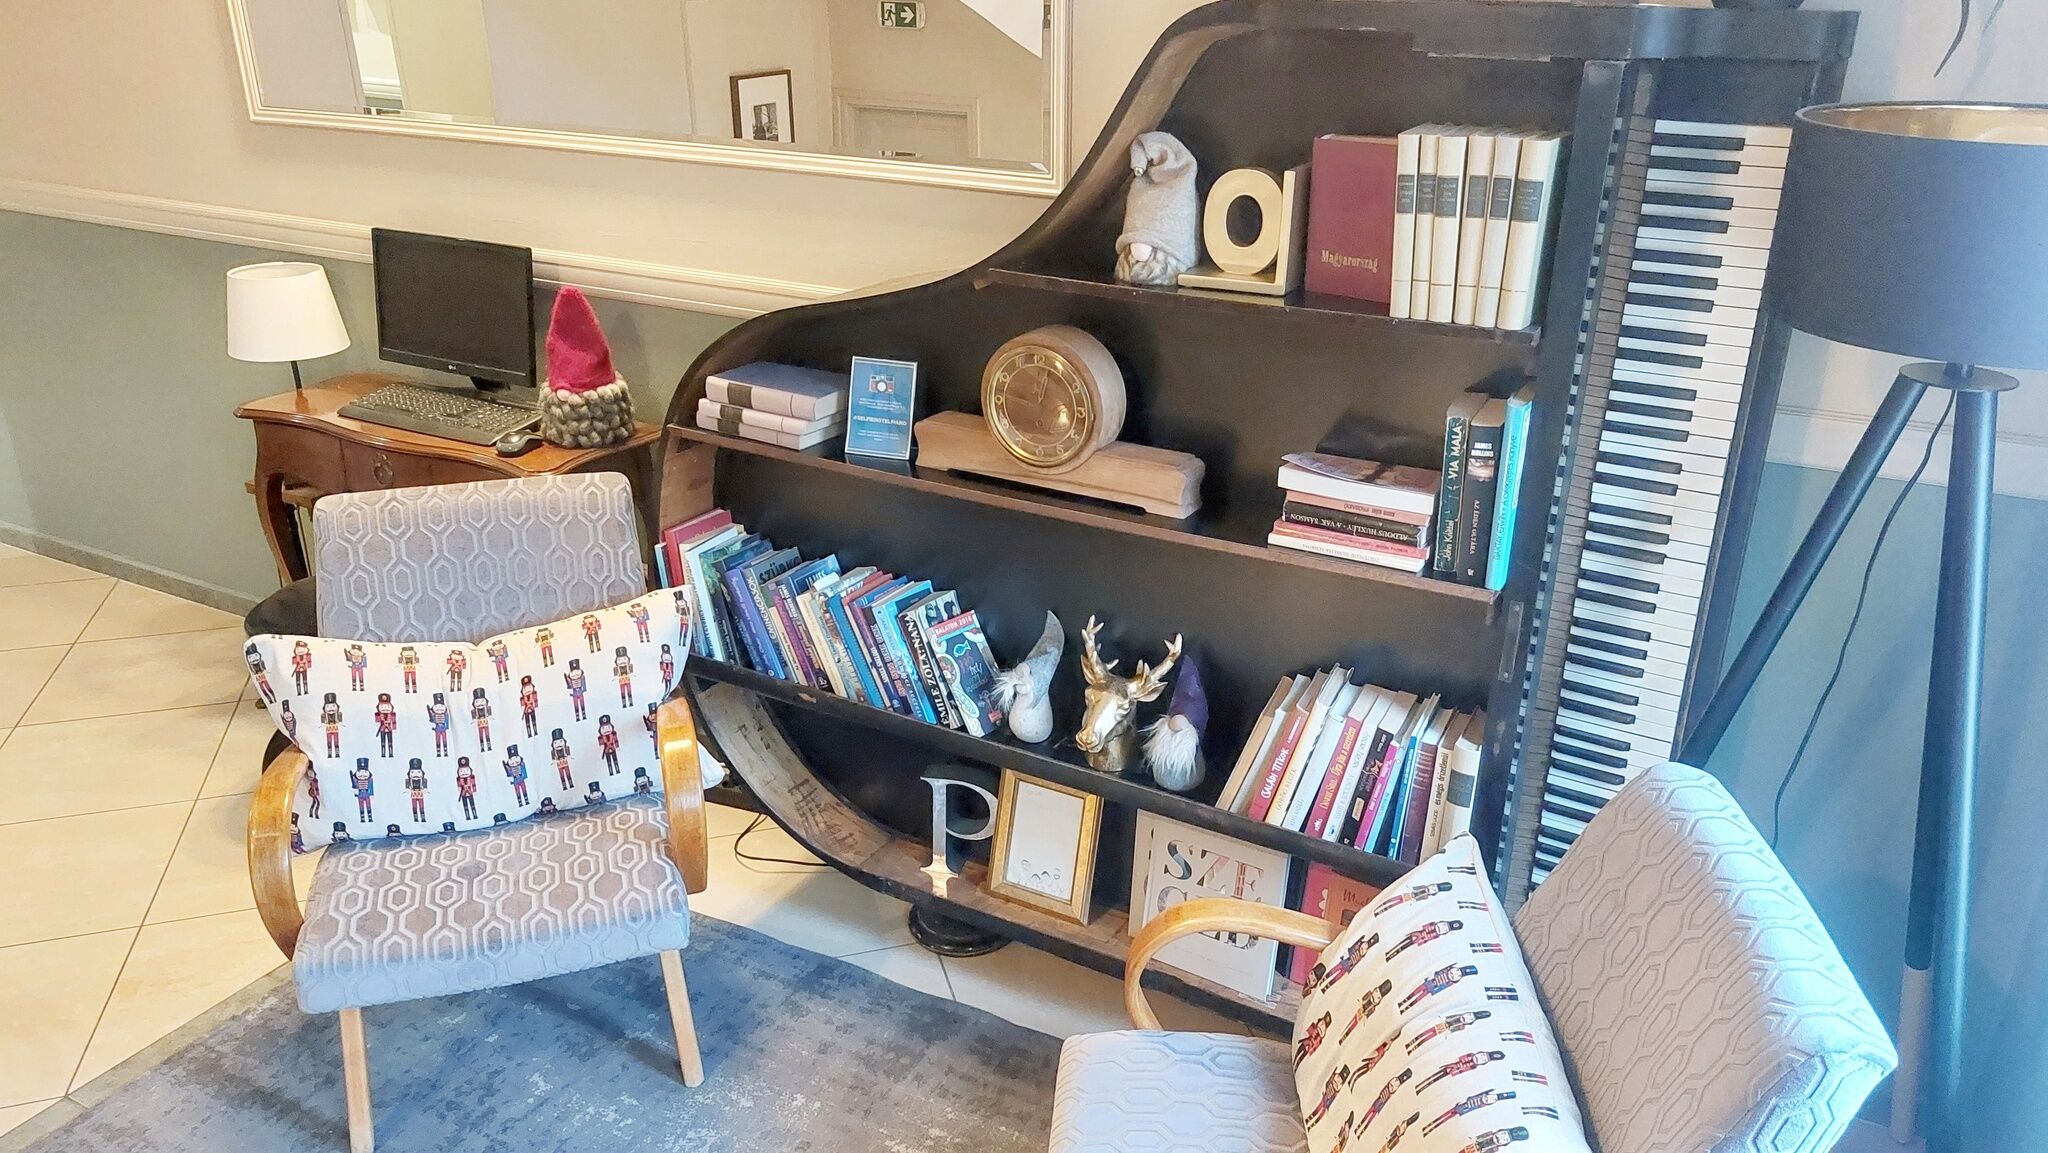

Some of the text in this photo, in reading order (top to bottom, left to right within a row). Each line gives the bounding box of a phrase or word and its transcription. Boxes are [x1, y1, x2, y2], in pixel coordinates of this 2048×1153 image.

[1322, 250, 1378, 273] Magyarország
[1447, 424, 1463, 479] VIA MALA
[1346, 523, 1377, 535] HUXLEY
[1377, 529, 1408, 540] ALDOUS
[1442, 543, 1452, 560] John
[902, 614, 924, 649] NANA
[1258, 745, 1290, 799] CSALÁDI TITKOK
[919, 776, 997, 878] P
